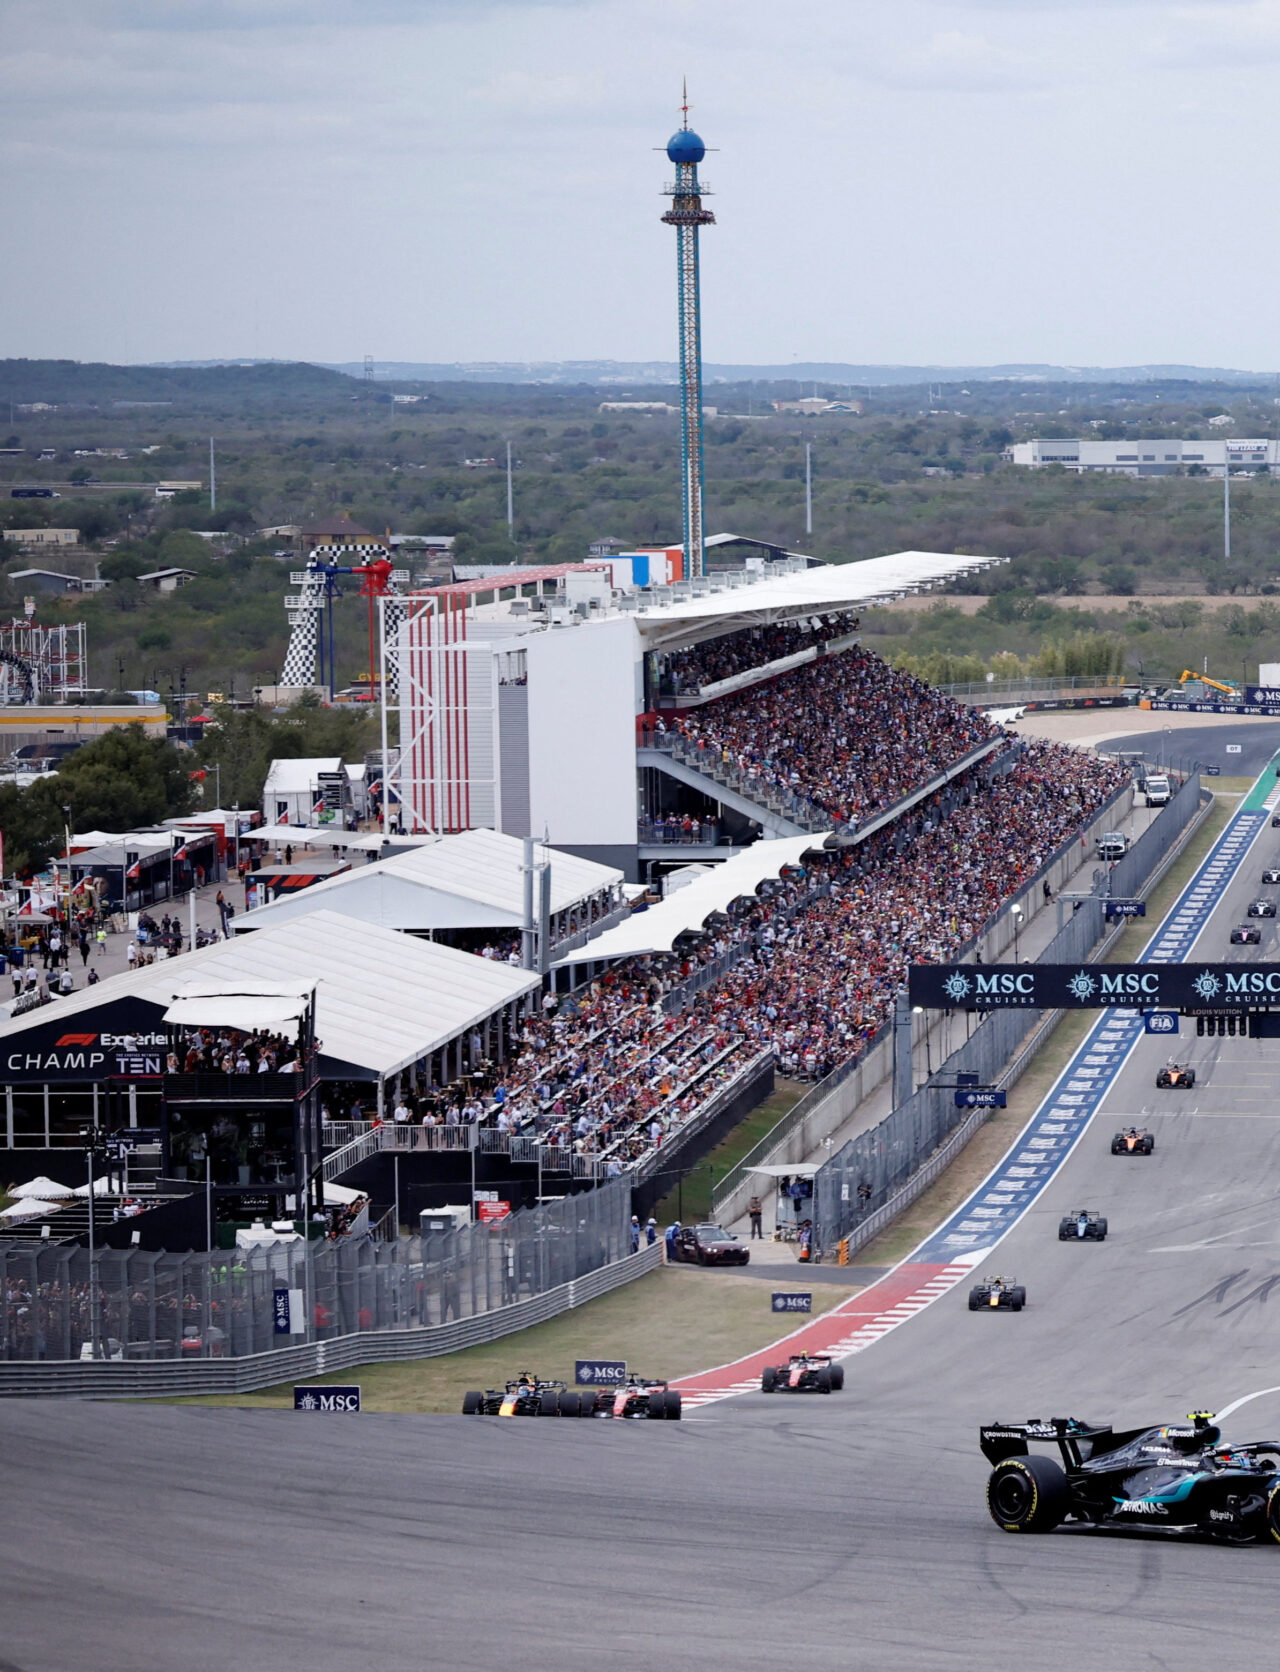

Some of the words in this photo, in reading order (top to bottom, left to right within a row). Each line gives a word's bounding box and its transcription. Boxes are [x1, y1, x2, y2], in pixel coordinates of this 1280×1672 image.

[976, 974, 1034, 994] MSC
[1101, 974, 1160, 994] MSC
[1150, 1018, 1171, 1028] FIA
[8, 1053, 104, 1070] CHAMP
[116, 1058, 160, 1074] TEN
[277, 1295, 285, 1316] MSC
[787, 1298, 810, 1306] MSC
[594, 1367, 624, 1378] MSC
[320, 1395, 357, 1411] MSC
[1168, 1429, 1195, 1437] Microsoft
[1164, 1459, 1200, 1467] TeamViewer
[1120, 1501, 1169, 1515] PETRONAS
